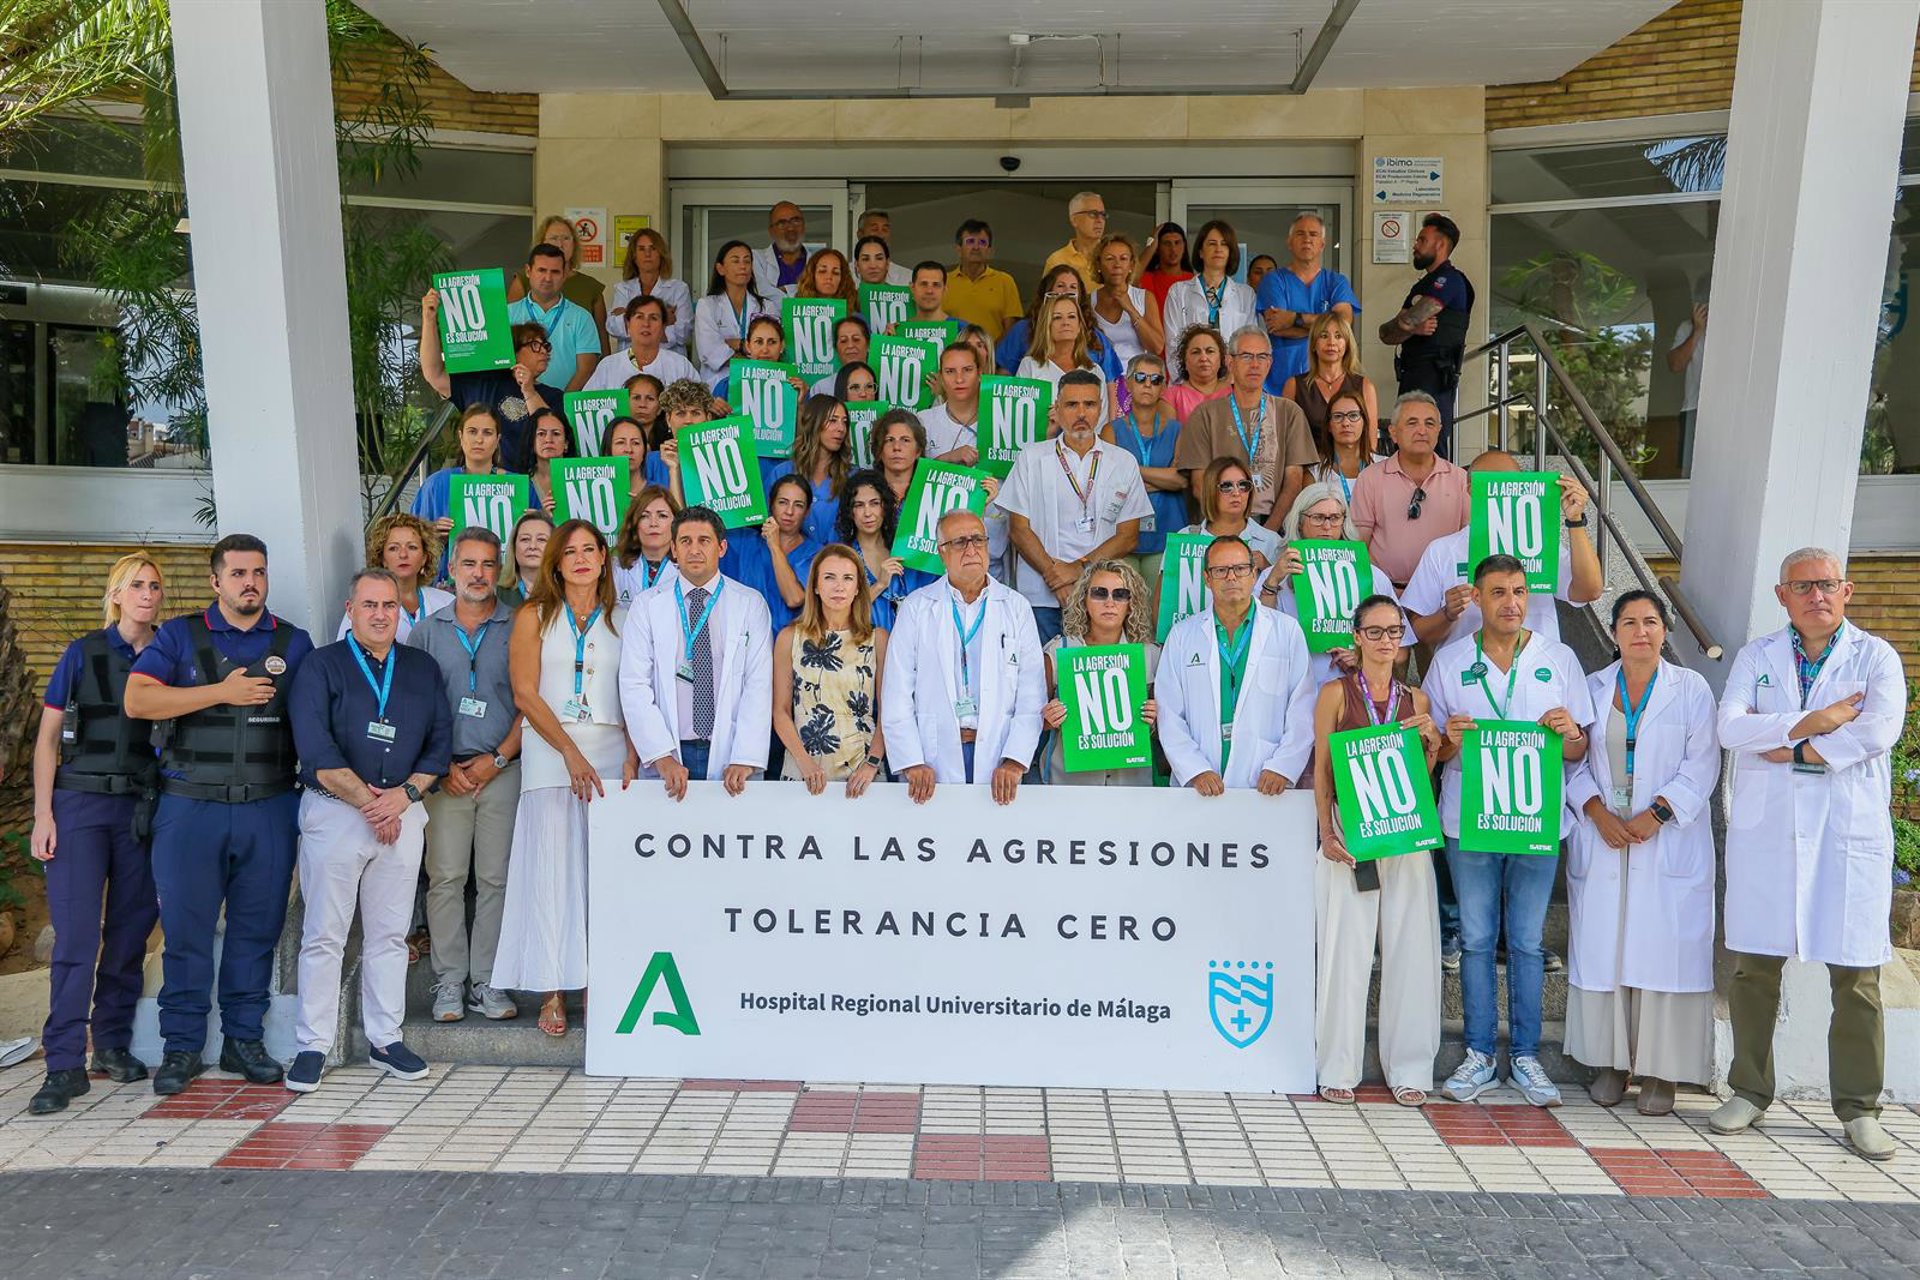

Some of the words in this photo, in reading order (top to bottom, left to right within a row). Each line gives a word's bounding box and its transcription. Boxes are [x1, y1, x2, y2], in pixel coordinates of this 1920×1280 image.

[438, 278, 448, 289] LA
[448, 274, 481, 288] AGRESIÓN
[869, 291, 878, 301] LA
[878, 291, 909, 303] AGRESIÓN
[440, 284, 486, 333] NO
[792, 305, 801, 316] LA
[802, 304, 835, 317] AGRESIÓN
[446, 332, 455, 344] ES
[456, 329, 488, 343] SOLUCIÓN
[792, 315, 834, 366] NO
[905, 327, 913, 338] LA
[914, 326, 947, 339] AGRESIÓN
[881, 343, 890, 356] LA
[891, 344, 926, 361] AGRESIÓN
[742, 367, 751, 379] LA
[752, 367, 787, 382] AGRESIÓN
[801, 362, 834, 375] SOLUCIÓN
[880, 355, 922, 407] NO
[993, 383, 1002, 396] LA
[1003, 384, 1040, 400] AGRESIÓN
[574, 399, 583, 412] LA
[583, 396, 618, 412] AGRESIÓN
[741, 379, 784, 429] NO
[992, 396, 1036, 451] NO
[689, 432, 700, 446] LA
[701, 424, 740, 445] AGRESIÓN
[988, 447, 997, 460] ES
[564, 467, 575, 480] LA
[576, 463, 616, 480] AGRESIÓN
[692, 437, 748, 501] NO
[464, 483, 474, 496] LA
[475, 481, 515, 497] AGRESIÓN
[926, 469, 937, 482] LA
[937, 470, 977, 492] AGRESIÓN
[1487, 481, 1498, 496] LA
[1500, 480, 1545, 497] AGRESIÓN
[565, 477, 618, 534] NO
[712, 493, 752, 512] SOLUCIÓN
[1487, 494, 1543, 558] NO
[907, 535, 920, 550] ES
[1180, 542, 1191, 557] LA
[1305, 547, 1316, 562] LA
[1317, 547, 1357, 562] AGRESIÓN
[1306, 560, 1360, 621] NO
[1312, 619, 1321, 633] ES
[1072, 656, 1085, 673] LA
[1086, 652, 1130, 671] AGRESIÓN
[1074, 667, 1133, 736] NO
[1078, 734, 1090, 750] ES
[1091, 730, 1135, 750] SOLUCIÓN
[1345, 741, 1358, 758] LA
[1358, 732, 1405, 756] AGRESIÓN
[1480, 729, 1493, 746] LA
[1494, 730, 1546, 749] AGRESIÓN
[1348, 747, 1417, 823] NO
[1480, 745, 1543, 815] NO
[1360, 820, 1373, 839] ES
[1374, 812, 1423, 836] SOLUCIÓN
[1477, 813, 1490, 830] ES
[1492, 813, 1542, 833] SOLUCIÓN
[634, 833, 823, 860] CONTRA
[853, 836, 937, 863] LAS
[966, 838, 1270, 869] AGRESIONES
[724, 907, 1026, 938] TOLERANCIA
[1057, 913, 1177, 942] CERO
[740, 991, 826, 1015] Hospital
[831, 993, 921, 1017] Regional
[926, 995, 1062, 1017] Universitario
[1066, 998, 1092, 1017] de
[1097, 997, 1171, 1024] Málaga
